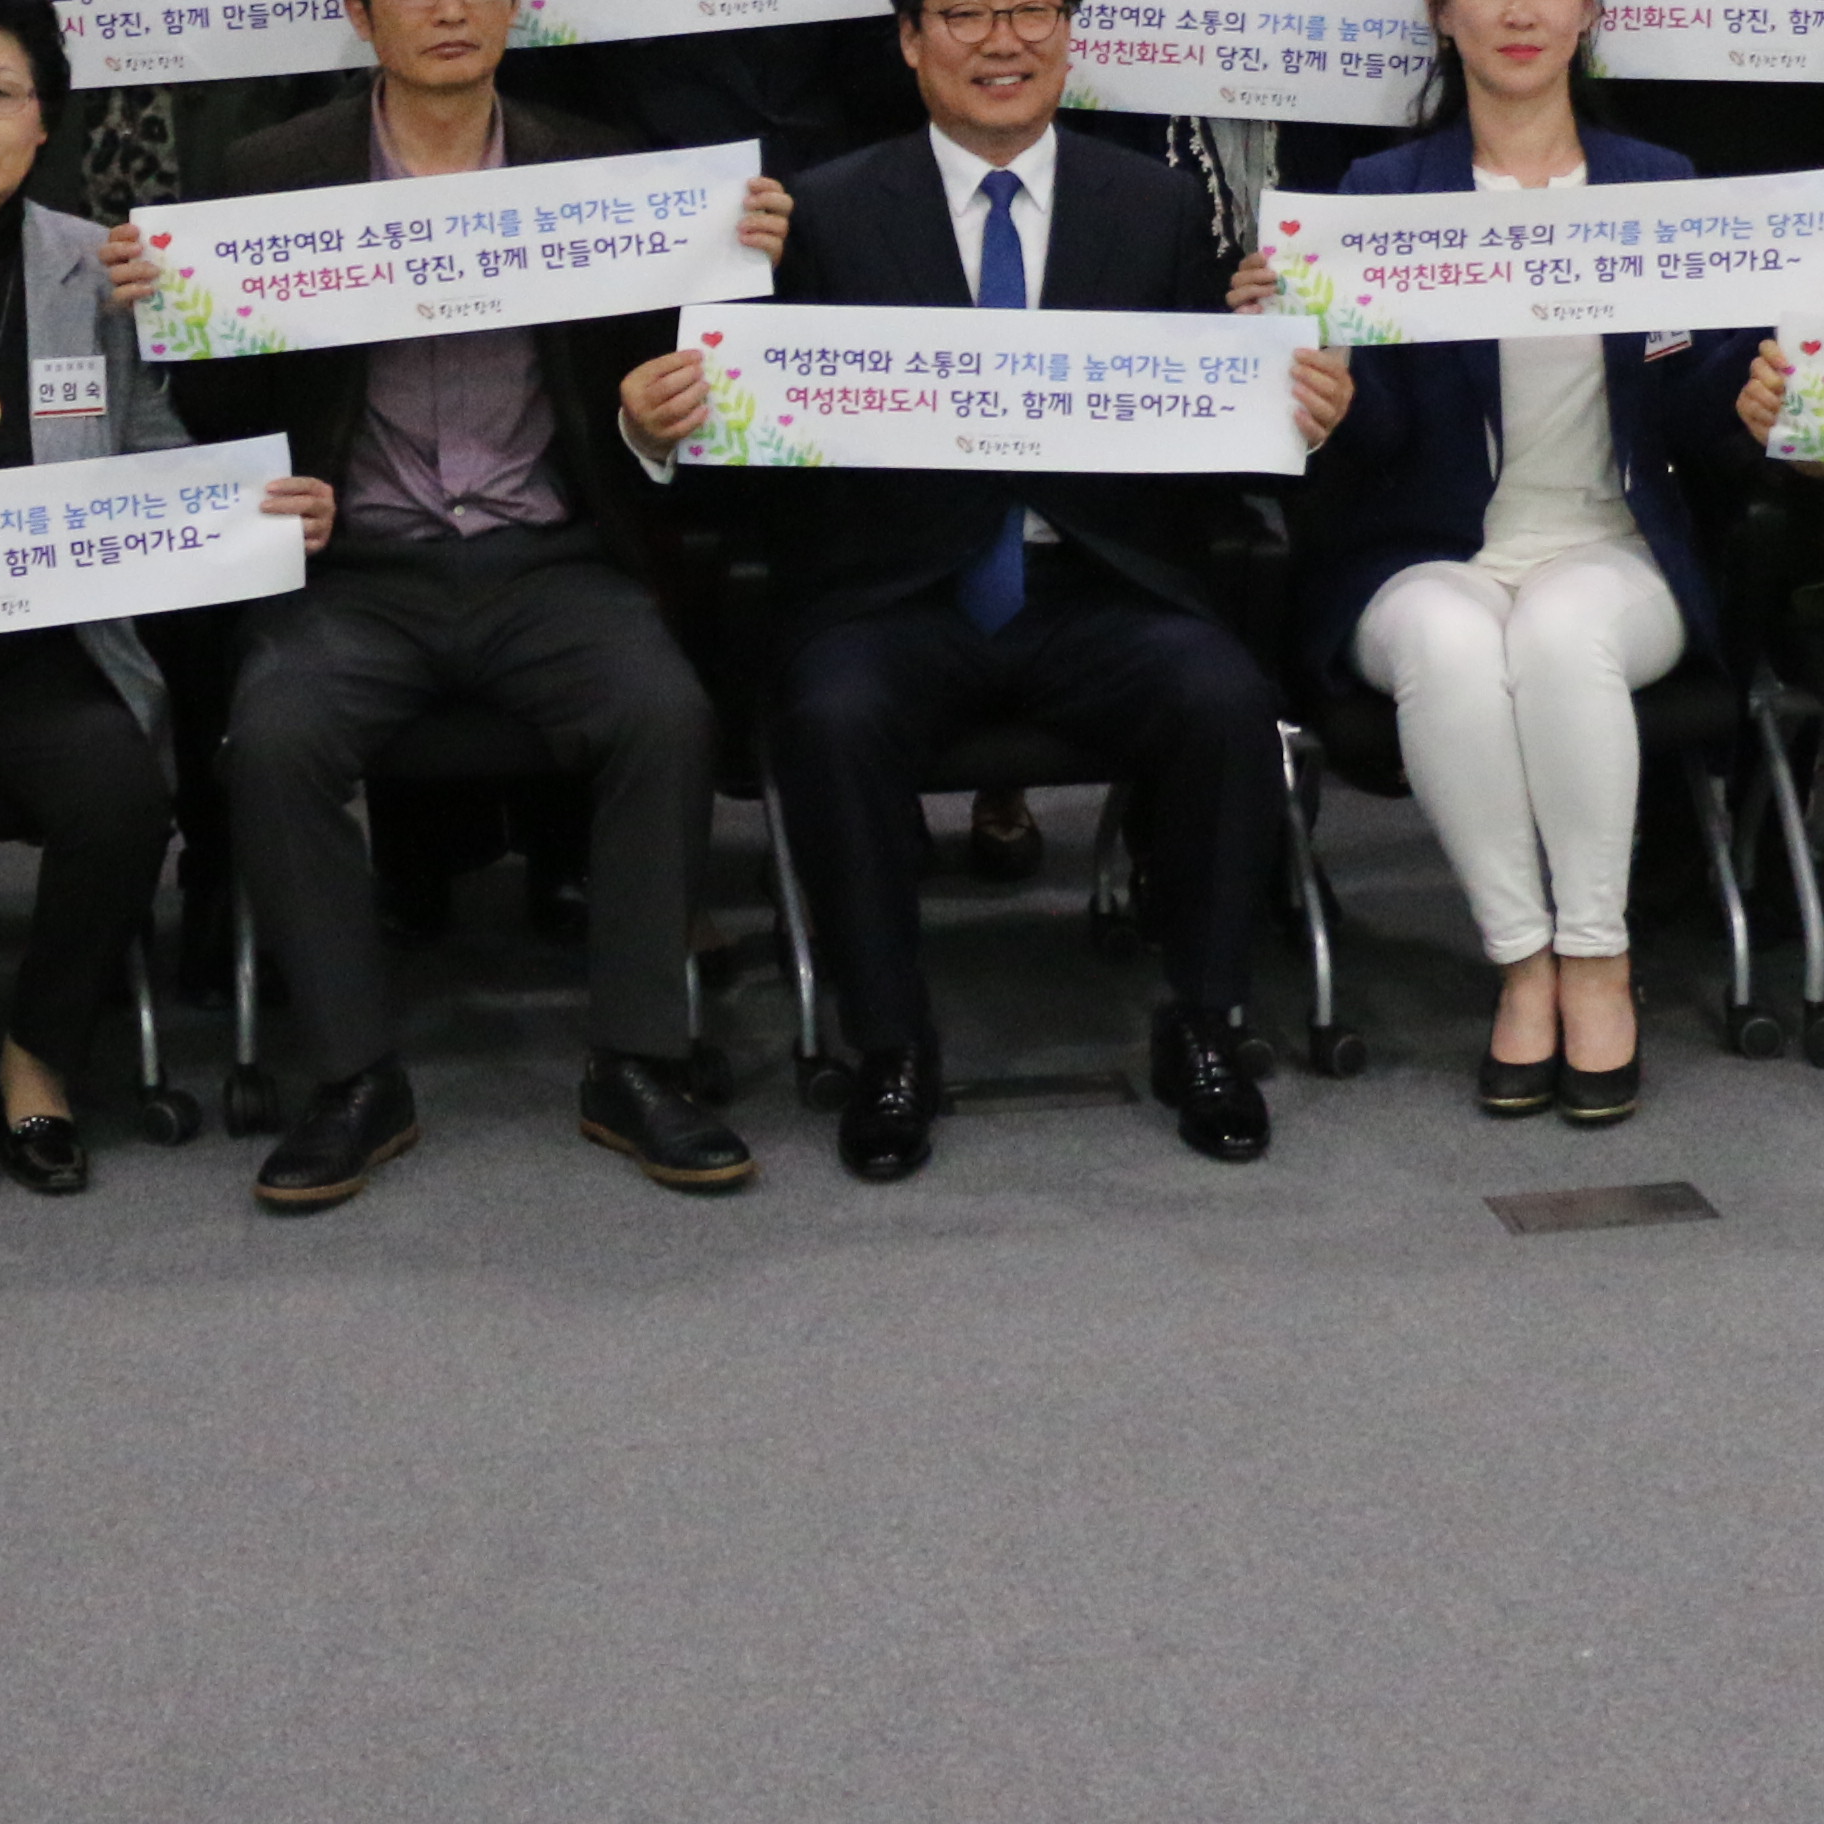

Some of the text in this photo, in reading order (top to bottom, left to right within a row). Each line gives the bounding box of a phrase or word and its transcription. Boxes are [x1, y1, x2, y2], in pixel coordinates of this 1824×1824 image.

[213, 188, 707, 267] 여성참여와 소통의 가치를 높여가는 당진!
[1339, 227, 1469, 257] 여성참여와
[1479, 223, 1556, 252] 소통의
[1567, 219, 1642, 246] 가치를
[1654, 215, 1754, 244] 높여가는
[240, 230, 689, 303] 여성친화도시 당진, 함께 만들어가요~
[1362, 247, 1802, 294] 여성친화도시 당진, 함께 만들어가요~
[762, 346, 1260, 385] 여성참여와 소통의 가치를 높여가는 당진!
[784, 385, 1236, 422] 여성친화도시 당진, 함께 만들어가요~
[63, 493, 167, 531] 높여가는
[178, 481, 240, 515] 당진!
[3, 543, 58, 578] 함께
[69, 525, 222, 569] 만들어가요~
